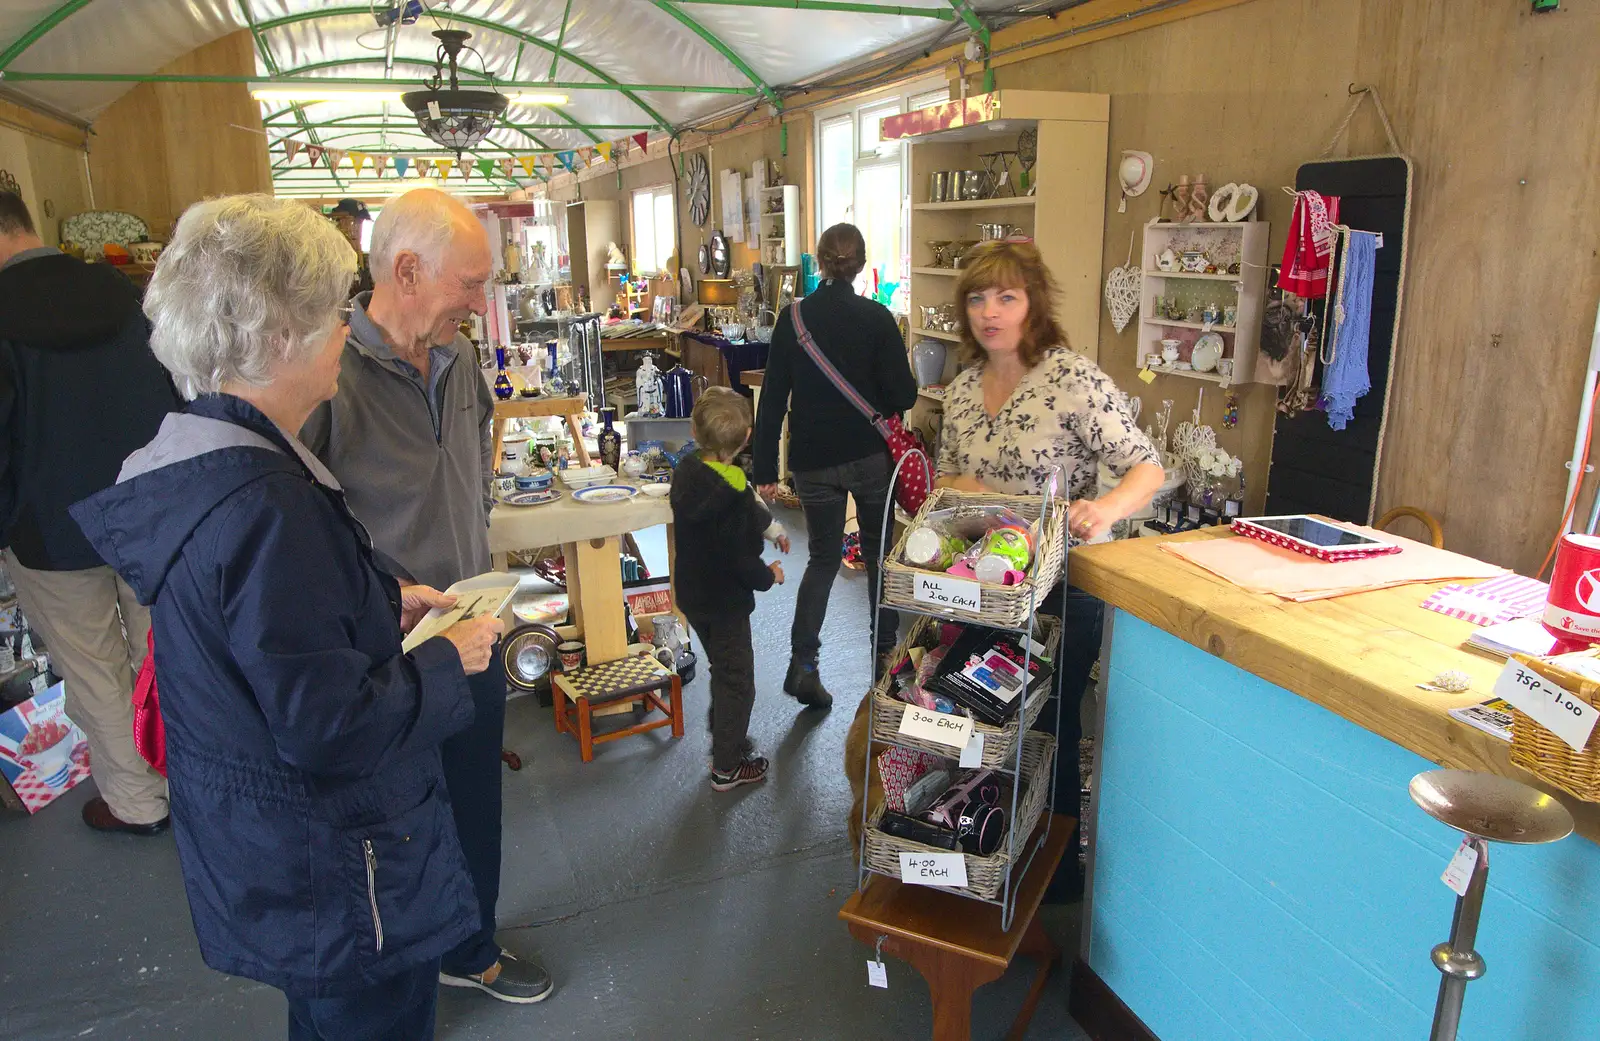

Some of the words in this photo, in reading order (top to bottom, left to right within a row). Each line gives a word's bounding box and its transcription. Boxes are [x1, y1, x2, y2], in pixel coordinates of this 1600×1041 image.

[922, 580, 942, 591] ALL
[928, 590, 949, 602] 2.00
[952, 595, 977, 608] EACH
[1574, 624, 1590, 633] Save
[912, 711, 933, 724] 3.00
[937, 717, 964, 732] EACH
[908, 858, 936, 869] 4.00
[920, 868, 949, 878] EACH
